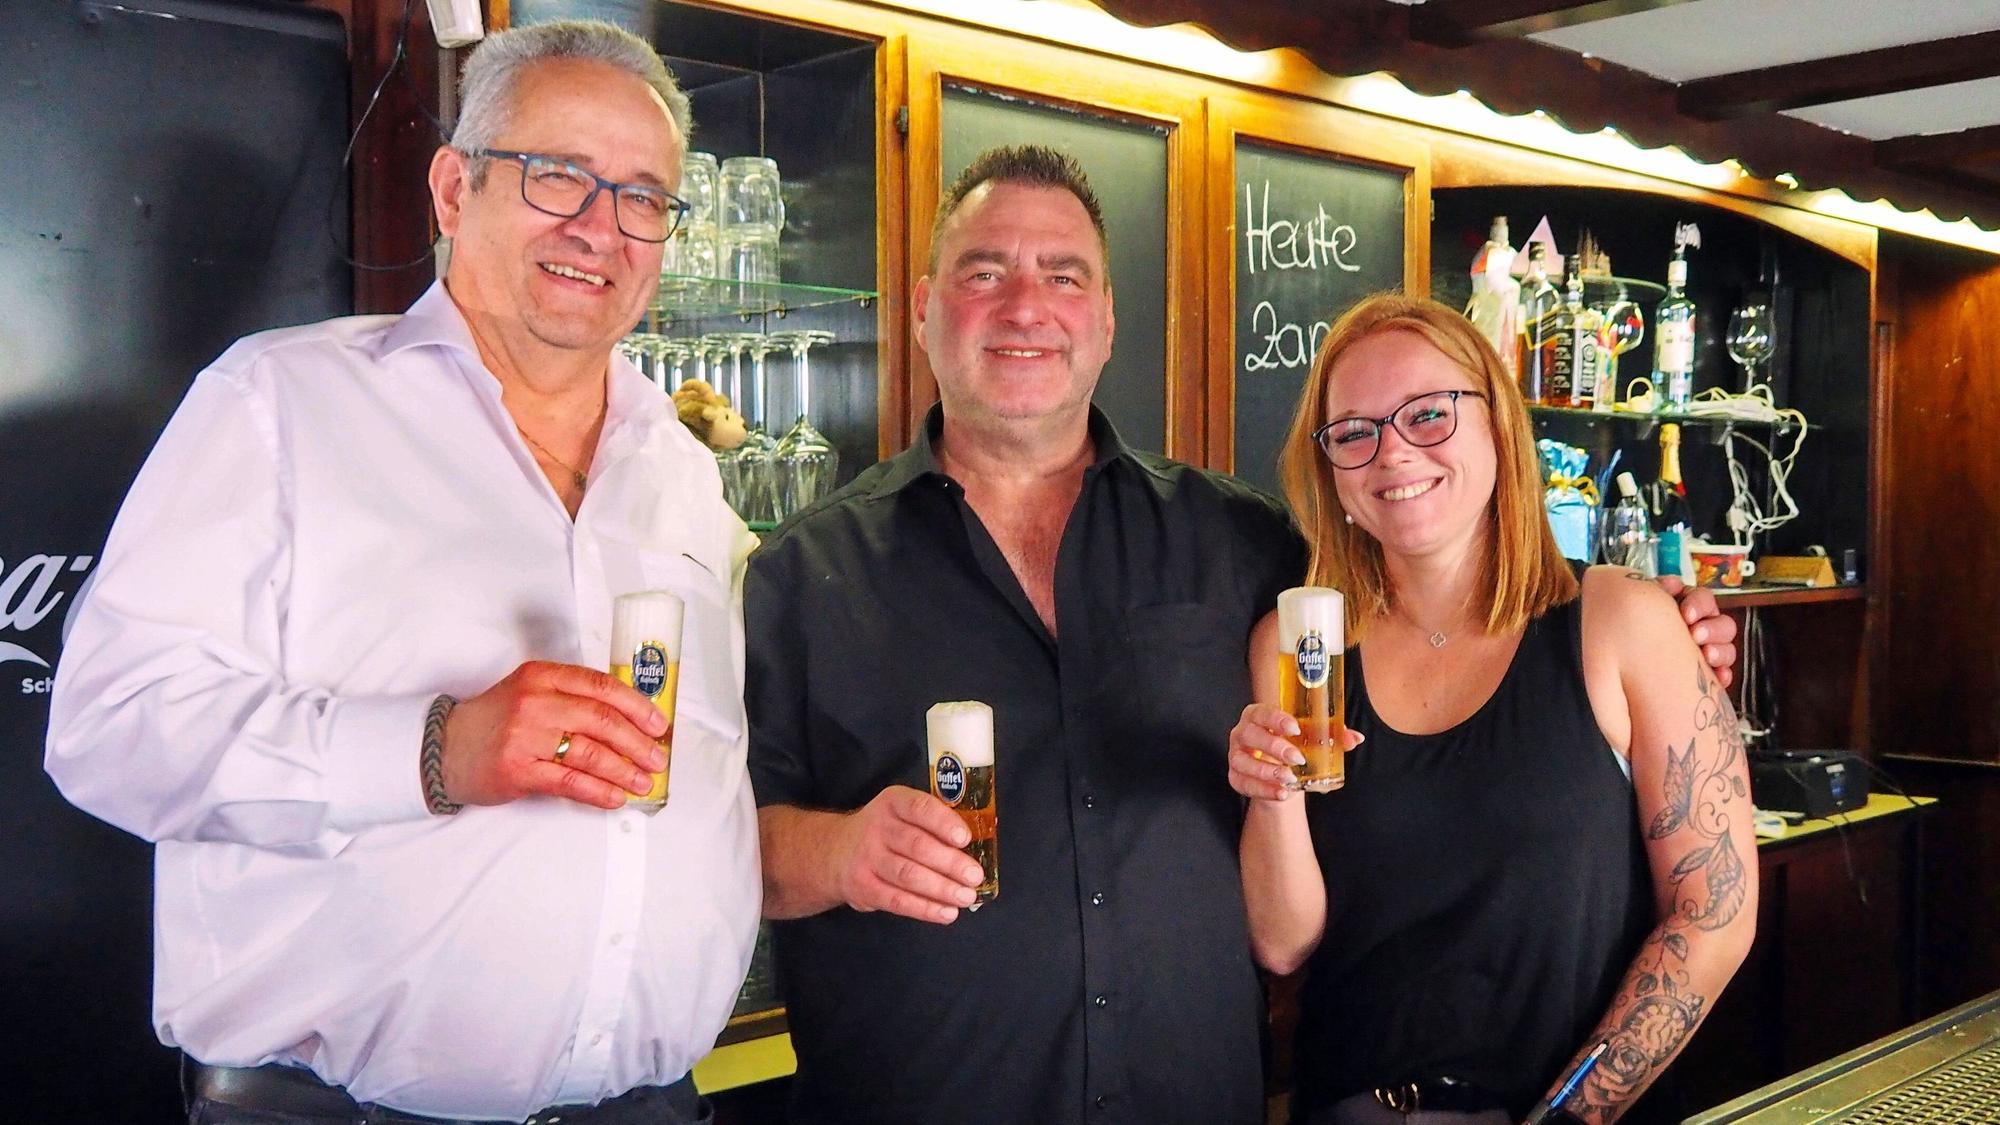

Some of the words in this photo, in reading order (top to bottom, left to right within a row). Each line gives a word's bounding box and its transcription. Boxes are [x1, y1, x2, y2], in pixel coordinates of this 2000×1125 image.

[1246, 179, 1361, 275] Heute
[635, 663, 664, 677] Gaffel
[937, 770, 962, 784] Gaffel
